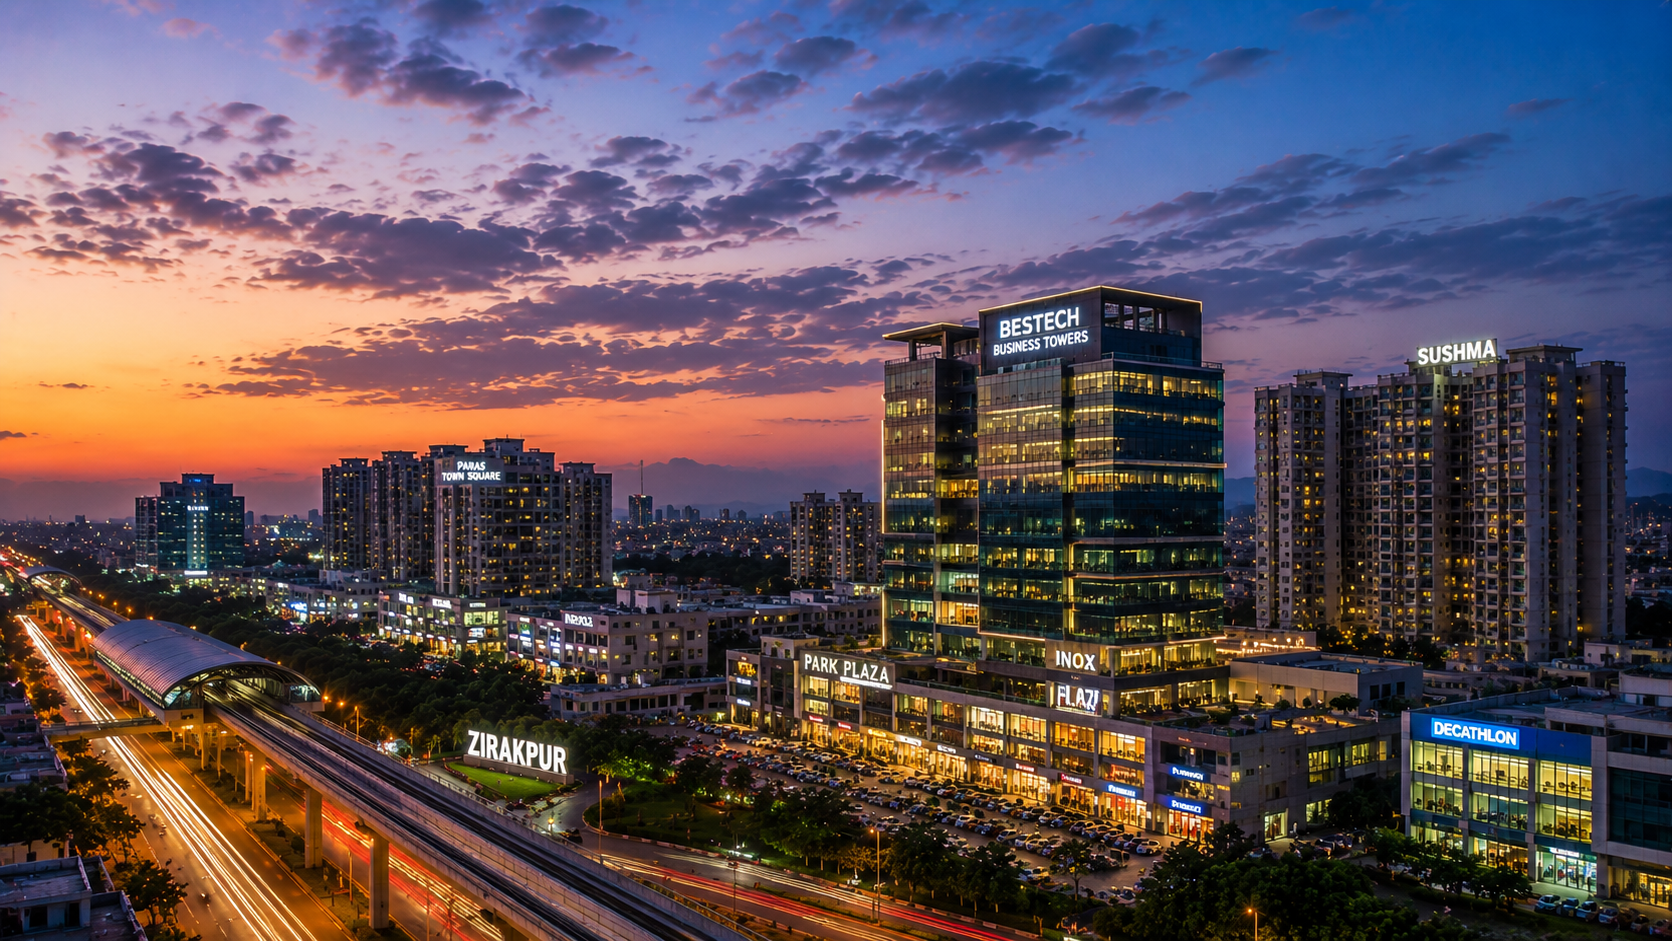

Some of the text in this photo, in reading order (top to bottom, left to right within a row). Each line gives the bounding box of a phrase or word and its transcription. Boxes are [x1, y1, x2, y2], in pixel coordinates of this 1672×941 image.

[1000, 306, 1079, 338] BESTECH
[993, 330, 1089, 356] BUSINESS TOWERS
[1418, 339, 1496, 365] SUSHMA
[467, 472, 501, 481] SQUARE
[804, 653, 838, 675] PARK
[844, 660, 889, 684] PLAZA
[1056, 650, 1096, 671] INOX
[1434, 721, 1517, 746] DECATHLON
[467, 729, 567, 775] ZIRAKPUR
